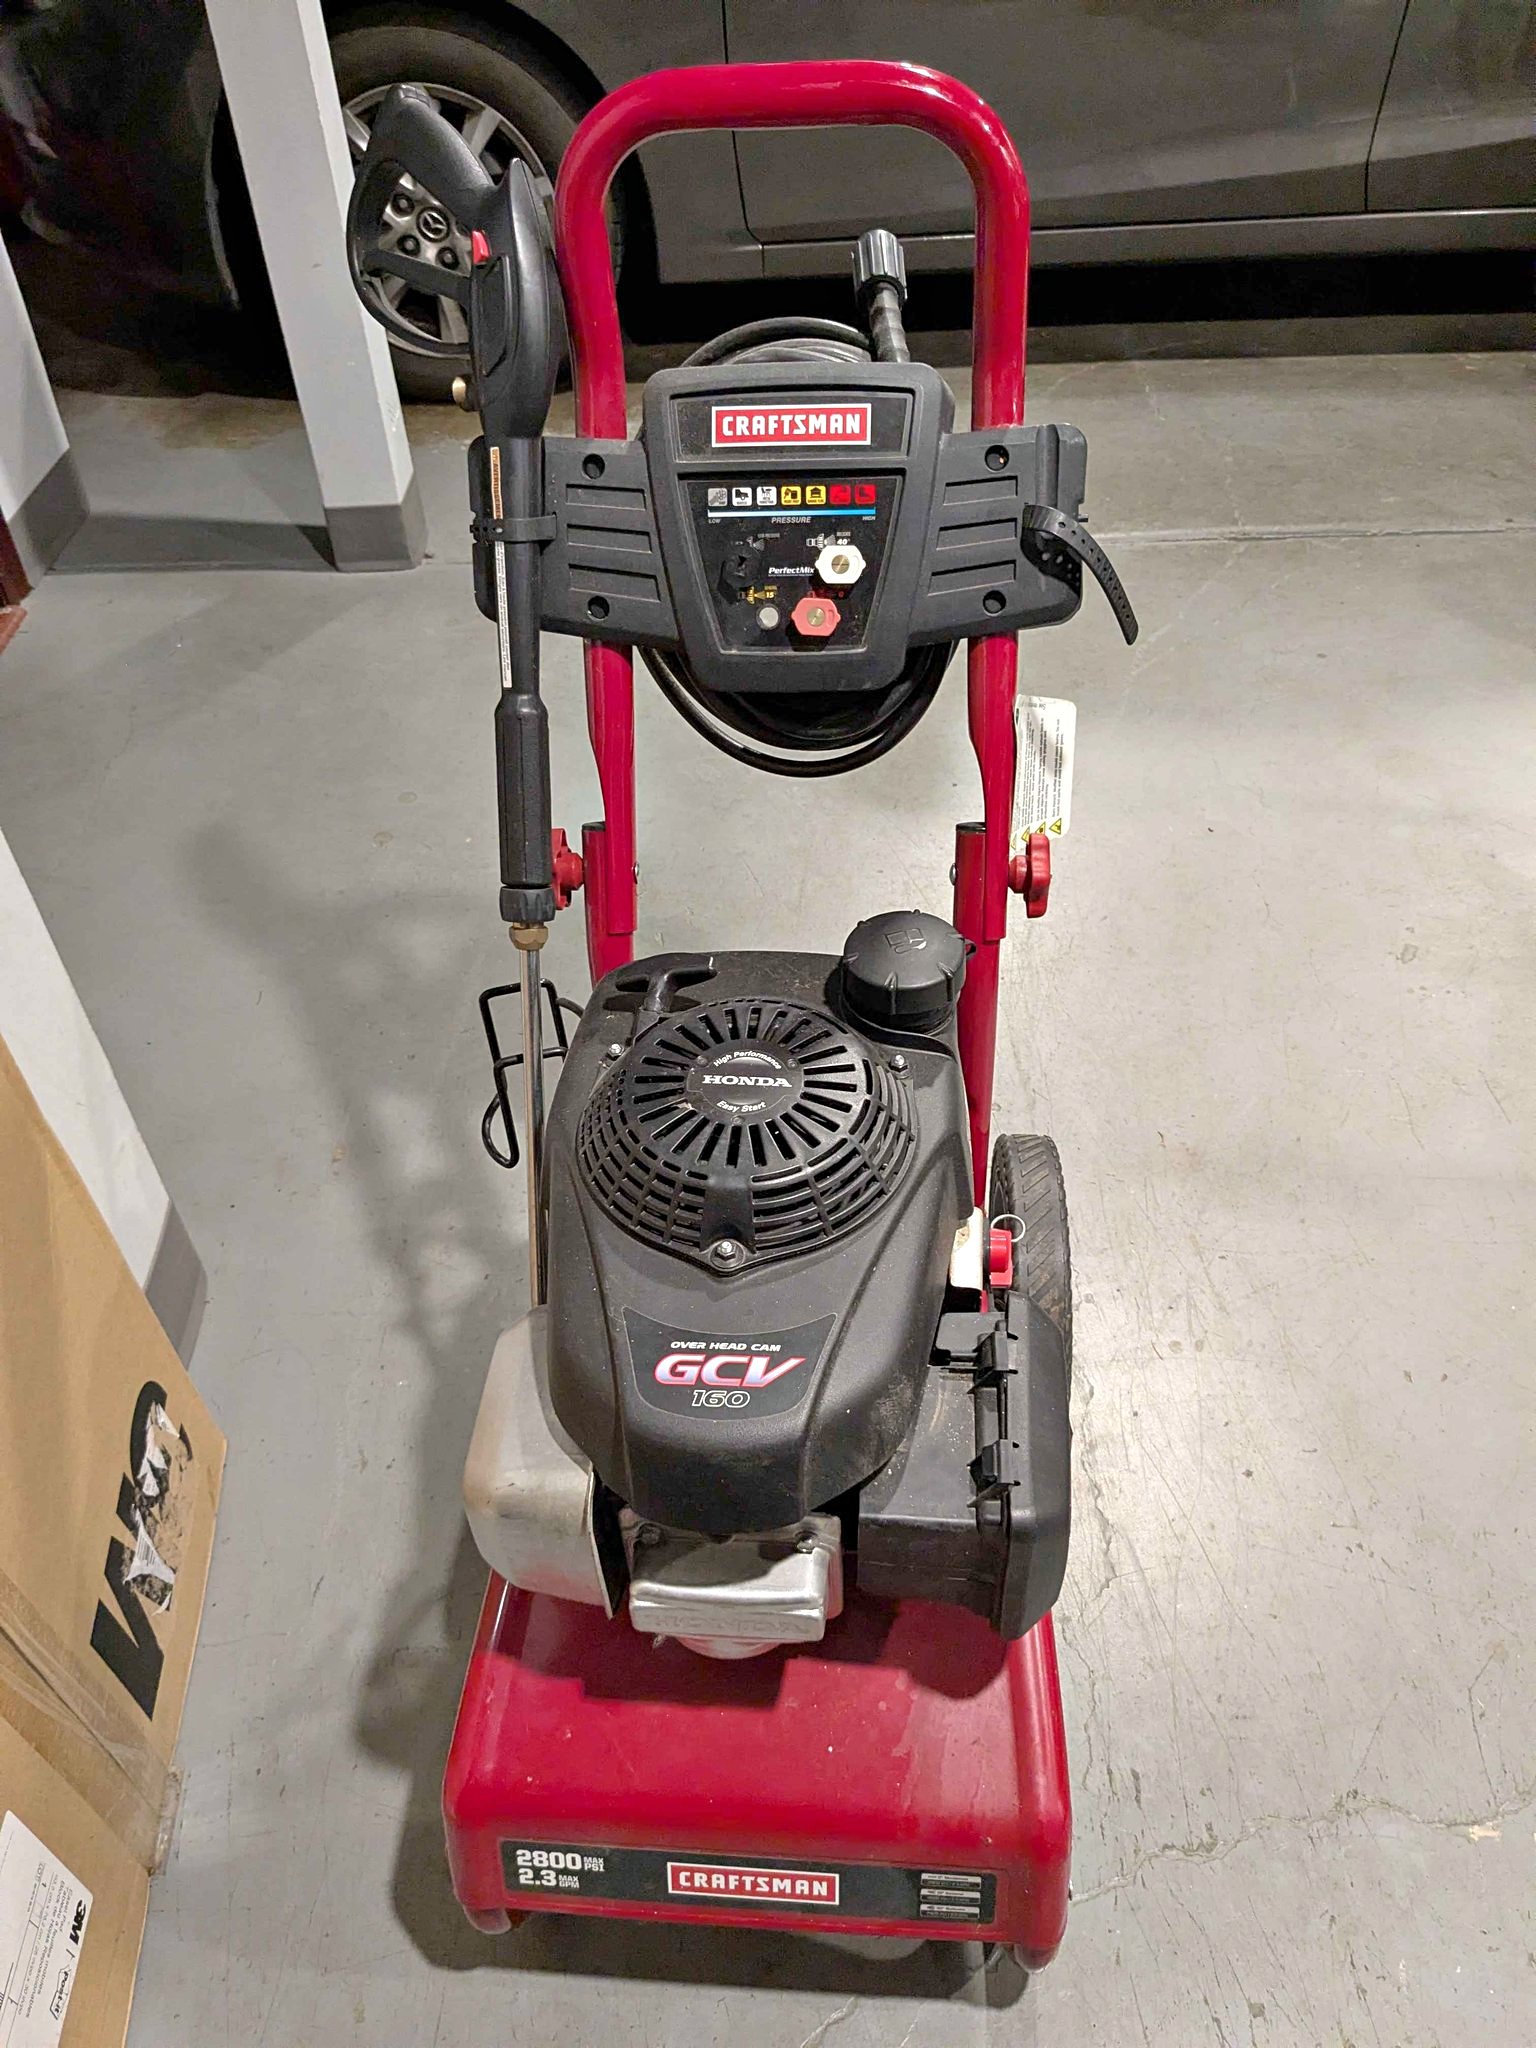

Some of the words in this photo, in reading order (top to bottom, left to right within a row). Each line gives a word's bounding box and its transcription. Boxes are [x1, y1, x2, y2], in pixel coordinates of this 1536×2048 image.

[722, 413, 861, 437] CRAFTSMAN
[771, 516, 812, 524] PRESSURE
[768, 566, 815, 574] PerfectMix
[713, 1054, 732, 1067] High
[734, 1050, 782, 1070] Performance
[702, 1074, 793, 1088] HONDA
[716, 1100, 740, 1113] Easy
[741, 1101, 767, 1113] Start
[670, 1341, 706, 1350] OVER
[709, 1342, 748, 1351] HEAD
[750, 1343, 782, 1353] CAM
[653, 1352, 808, 1389] GCV
[691, 1389, 751, 1409] 160
[515, 1849, 582, 1870] 2800
[583, 1856, 604, 1866] MAX
[584, 1864, 605, 1872] PSI
[518, 1867, 557, 1887] 2.3
[558, 1874, 579, 1882] MAX
[679, 1872, 828, 1896] CRAFTSMAN
[69, 1899, 87, 1945] 3M
[26, 1946, 47, 2018] Reposicionables
[54, 1970, 69, 2014] Post-it
